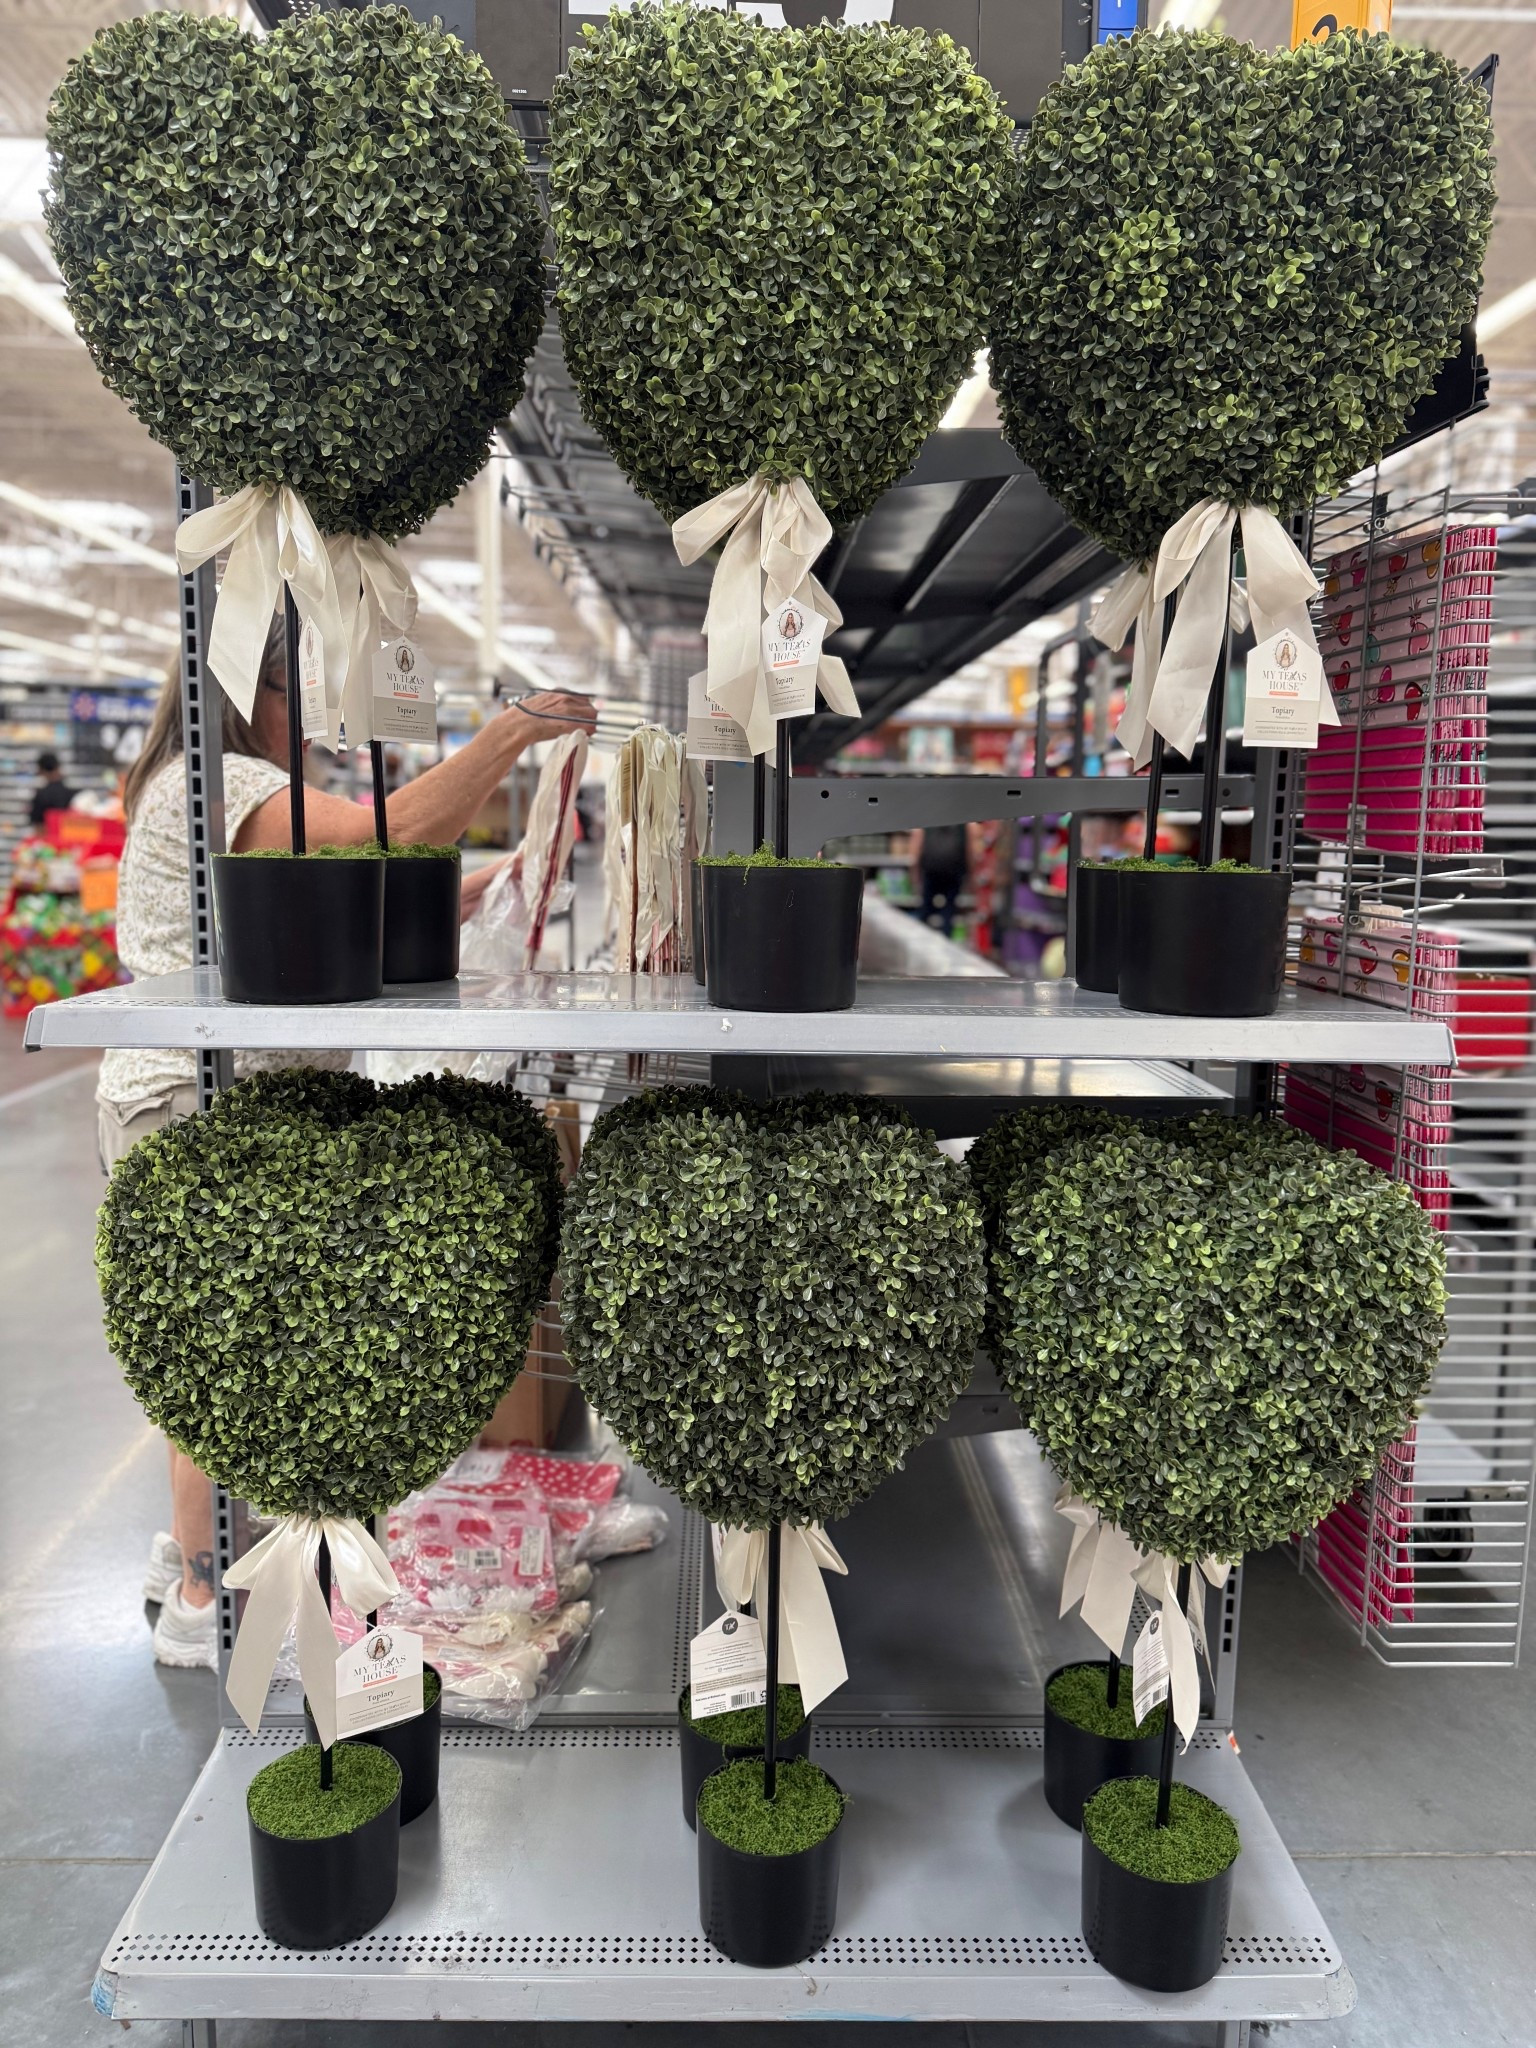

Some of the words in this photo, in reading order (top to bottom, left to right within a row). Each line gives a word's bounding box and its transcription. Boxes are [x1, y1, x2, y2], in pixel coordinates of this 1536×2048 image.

[767, 641, 779, 652] MY
[782, 638, 811, 652] TEXAS
[773, 650, 801, 662] HOUSE
[386, 672, 398, 682] MY
[400, 673, 425, 686] TEXAS
[775, 676, 794, 686] Topiary
[1263, 670, 1276, 680] MY
[1278, 670, 1307, 681] TEXAS
[393, 682, 419, 694] HOUSE
[1269, 680, 1300, 691] HOUSE
[397, 706, 417, 716] Topiary
[1271, 706, 1295, 716] Topiary
[714, 725, 736, 735] Topiary
[724, 1621, 736, 1631] TX
[354, 1666, 369, 1677] MY
[372, 1655, 407, 1672] TEXAS
[362, 1667, 399, 1683] HOUSE
[367, 1690, 395, 1702] Topiary
